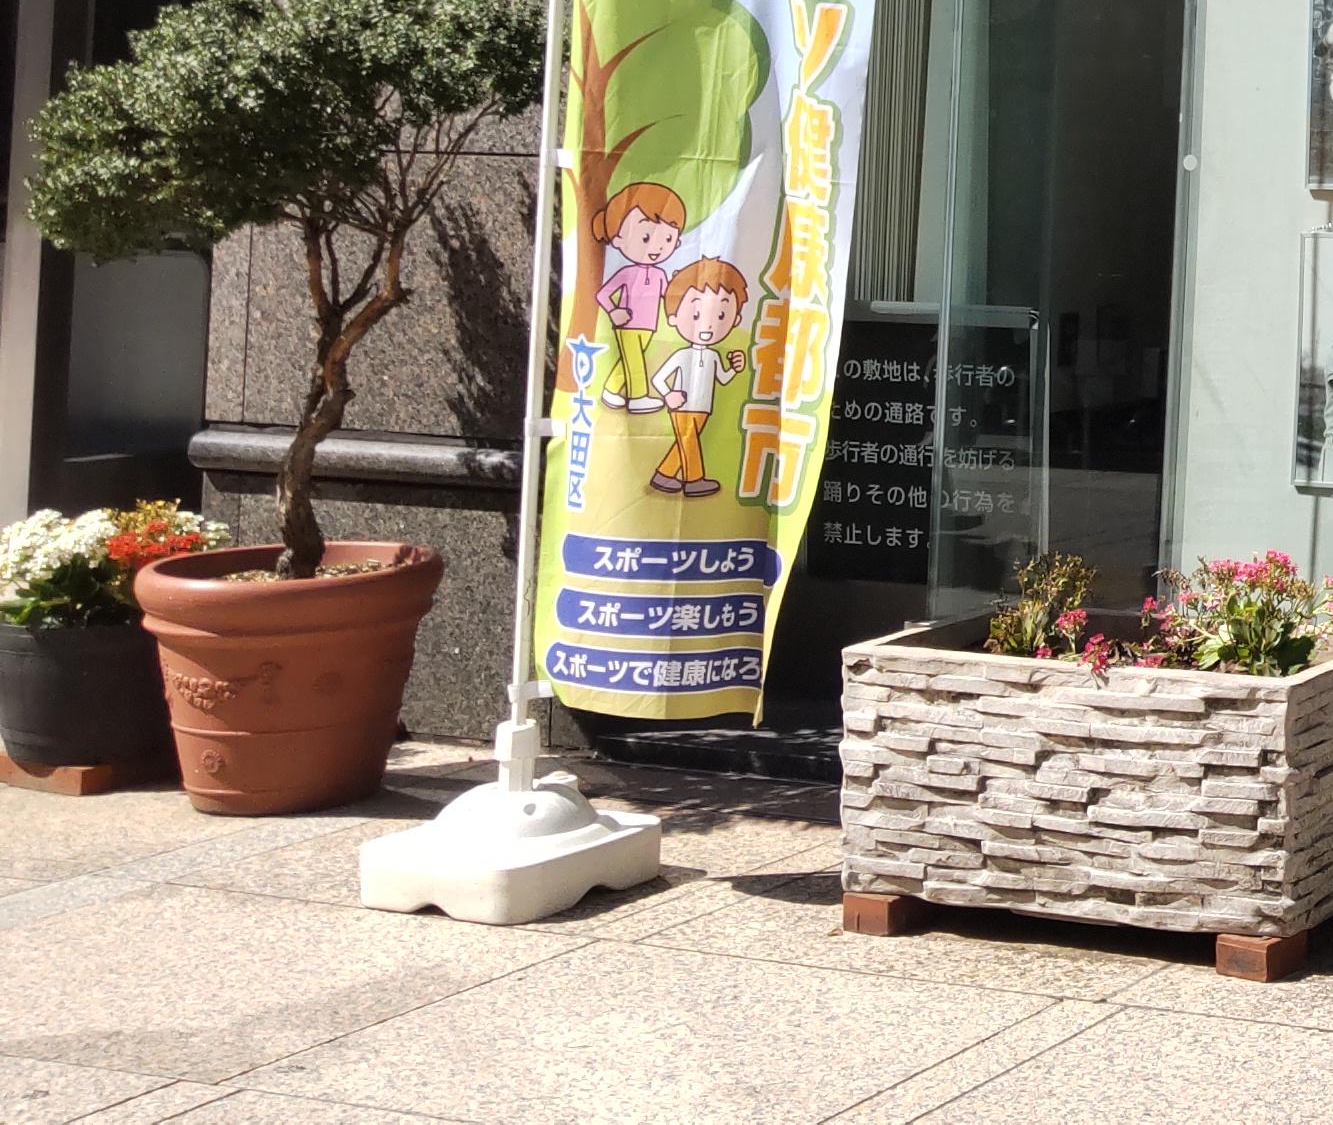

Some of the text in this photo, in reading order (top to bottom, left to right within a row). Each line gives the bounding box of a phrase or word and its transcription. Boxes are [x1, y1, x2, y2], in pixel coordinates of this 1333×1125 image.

[568, 390, 593, 509] 大田区
[593, 546, 755, 574] スポーツしよう
[577, 600, 758, 631] スポーツ楽しもう
[553, 650, 763, 687] スポーツで健康になろ
